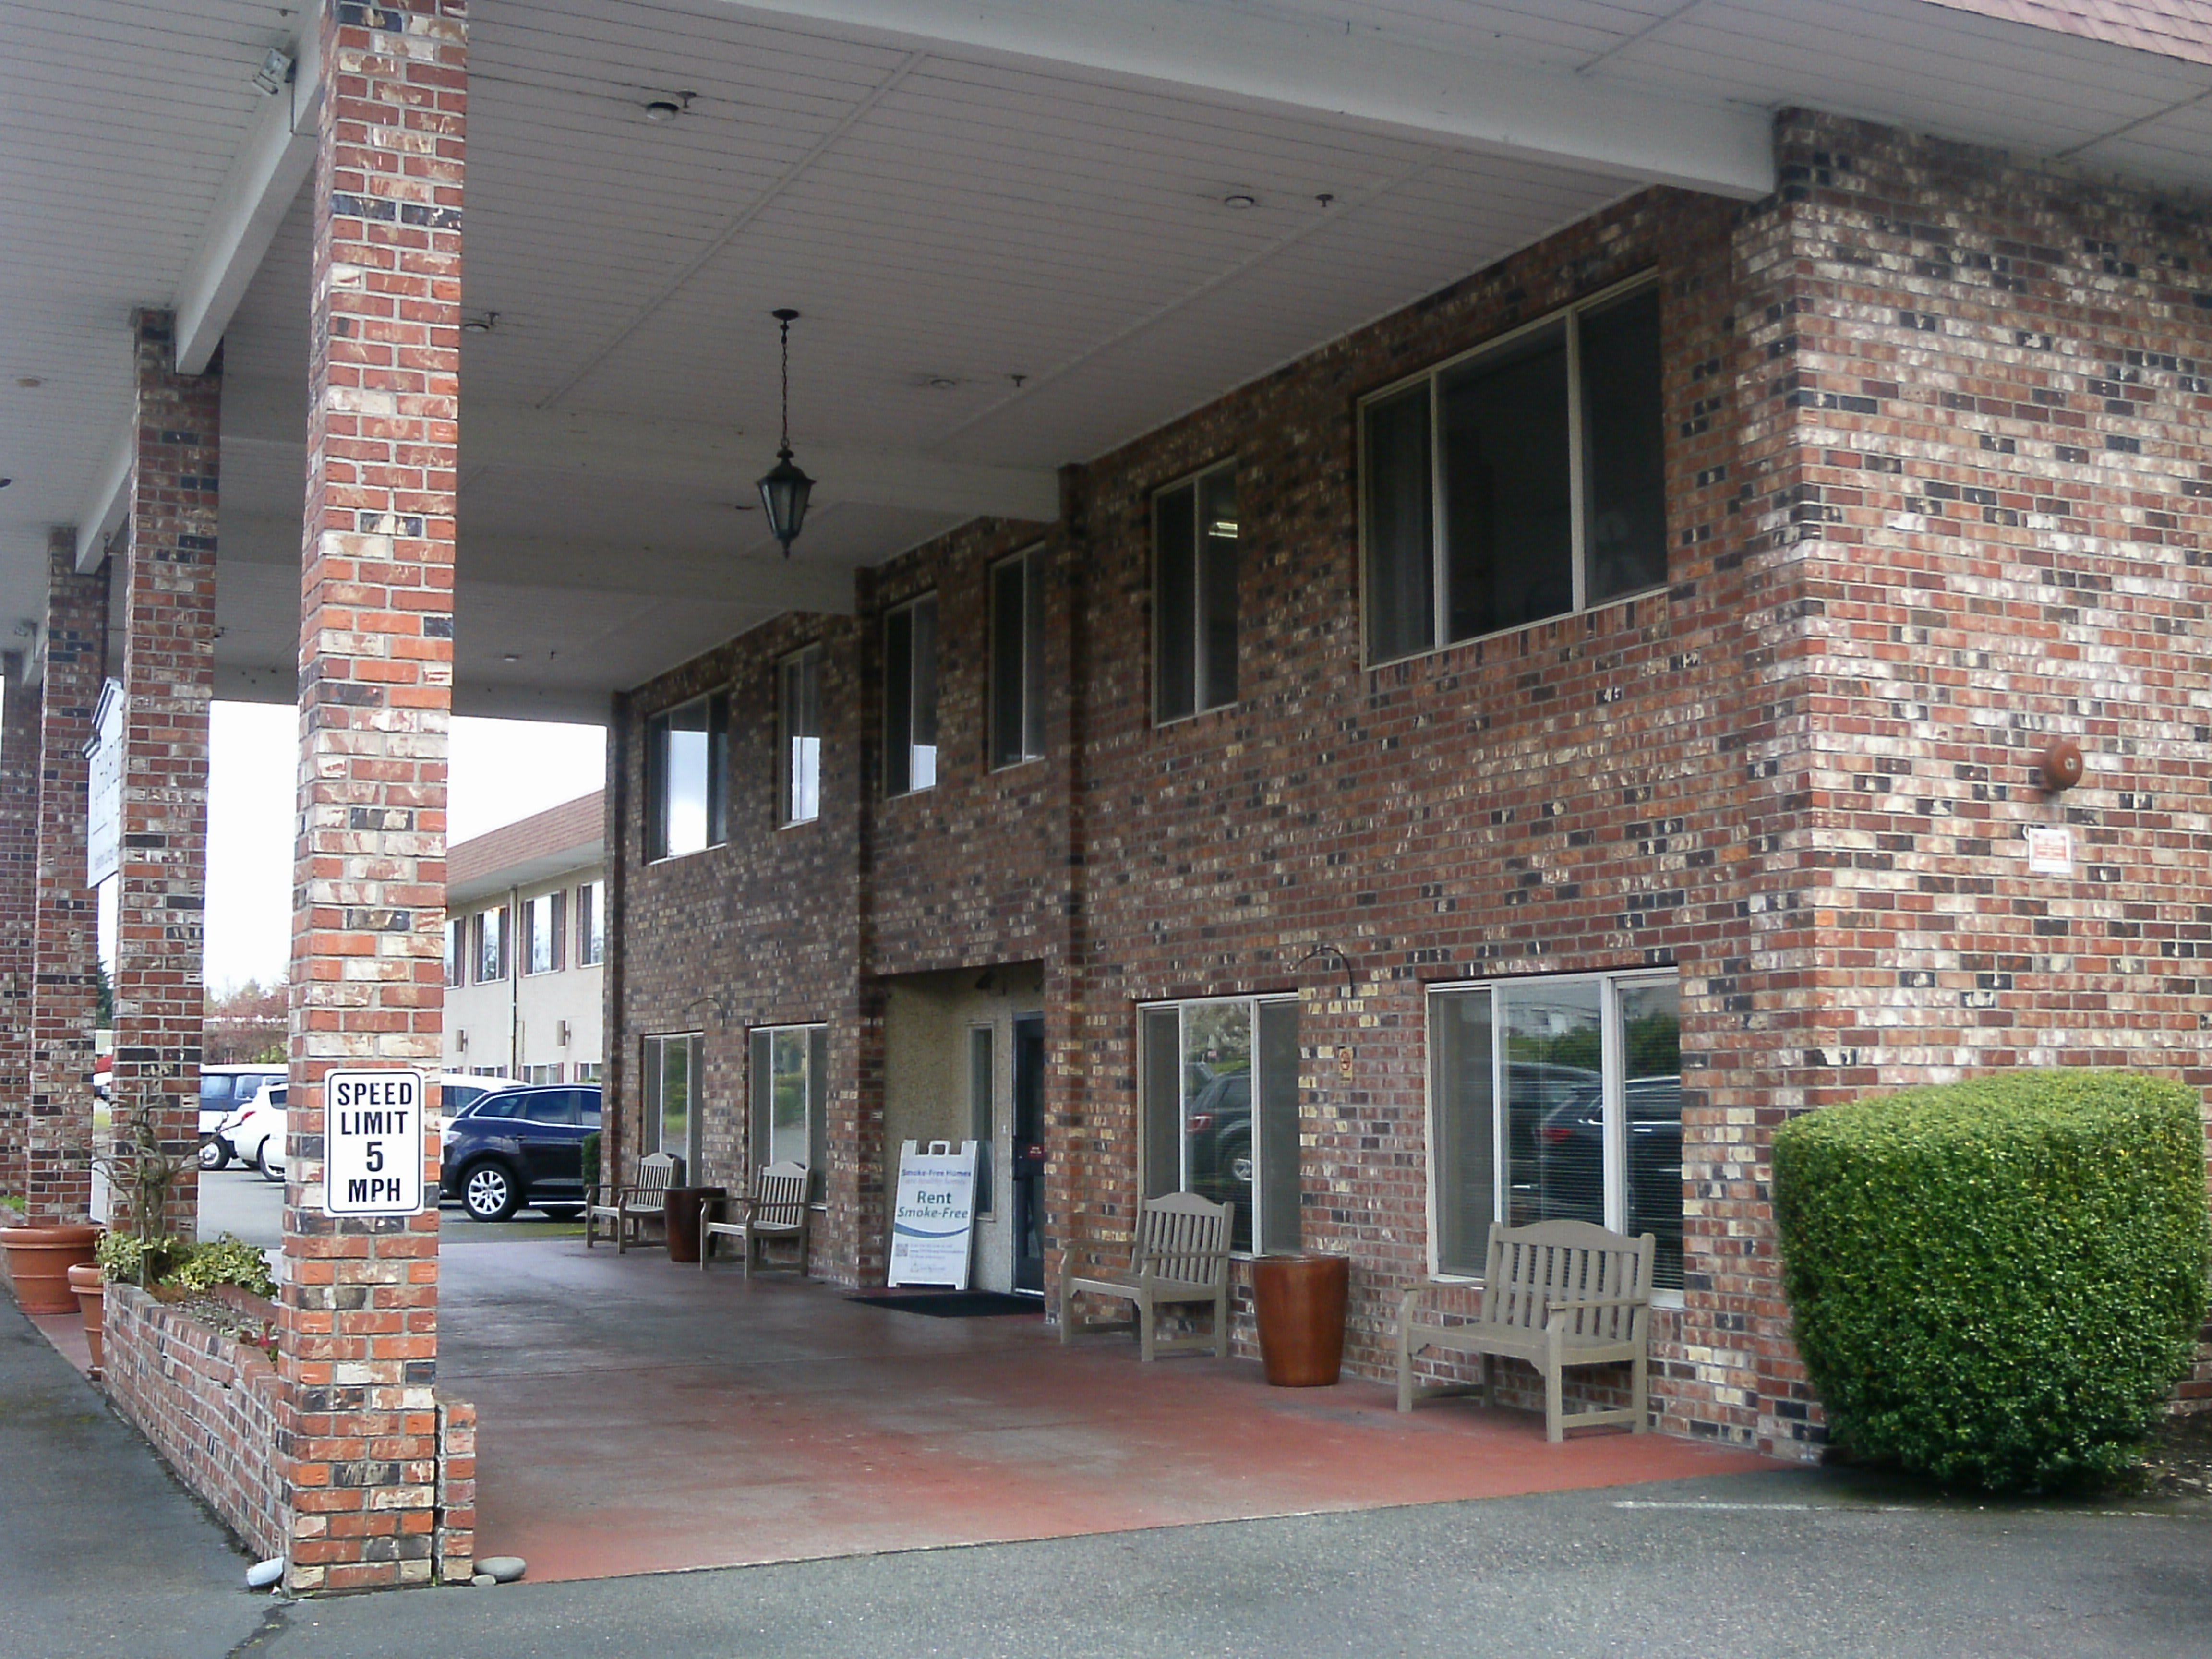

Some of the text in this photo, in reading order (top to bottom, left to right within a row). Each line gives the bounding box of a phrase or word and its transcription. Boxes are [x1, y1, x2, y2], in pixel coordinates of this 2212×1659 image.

[337, 1082, 412, 1106] SPEED
[341, 1111, 408, 1134] LIMIT
[366, 1142, 383, 1172] 5
[348, 1178, 400, 1202] MPH
[917, 1190, 952, 1204] Rent
[897, 1206, 969, 1218] Smoke-Free
